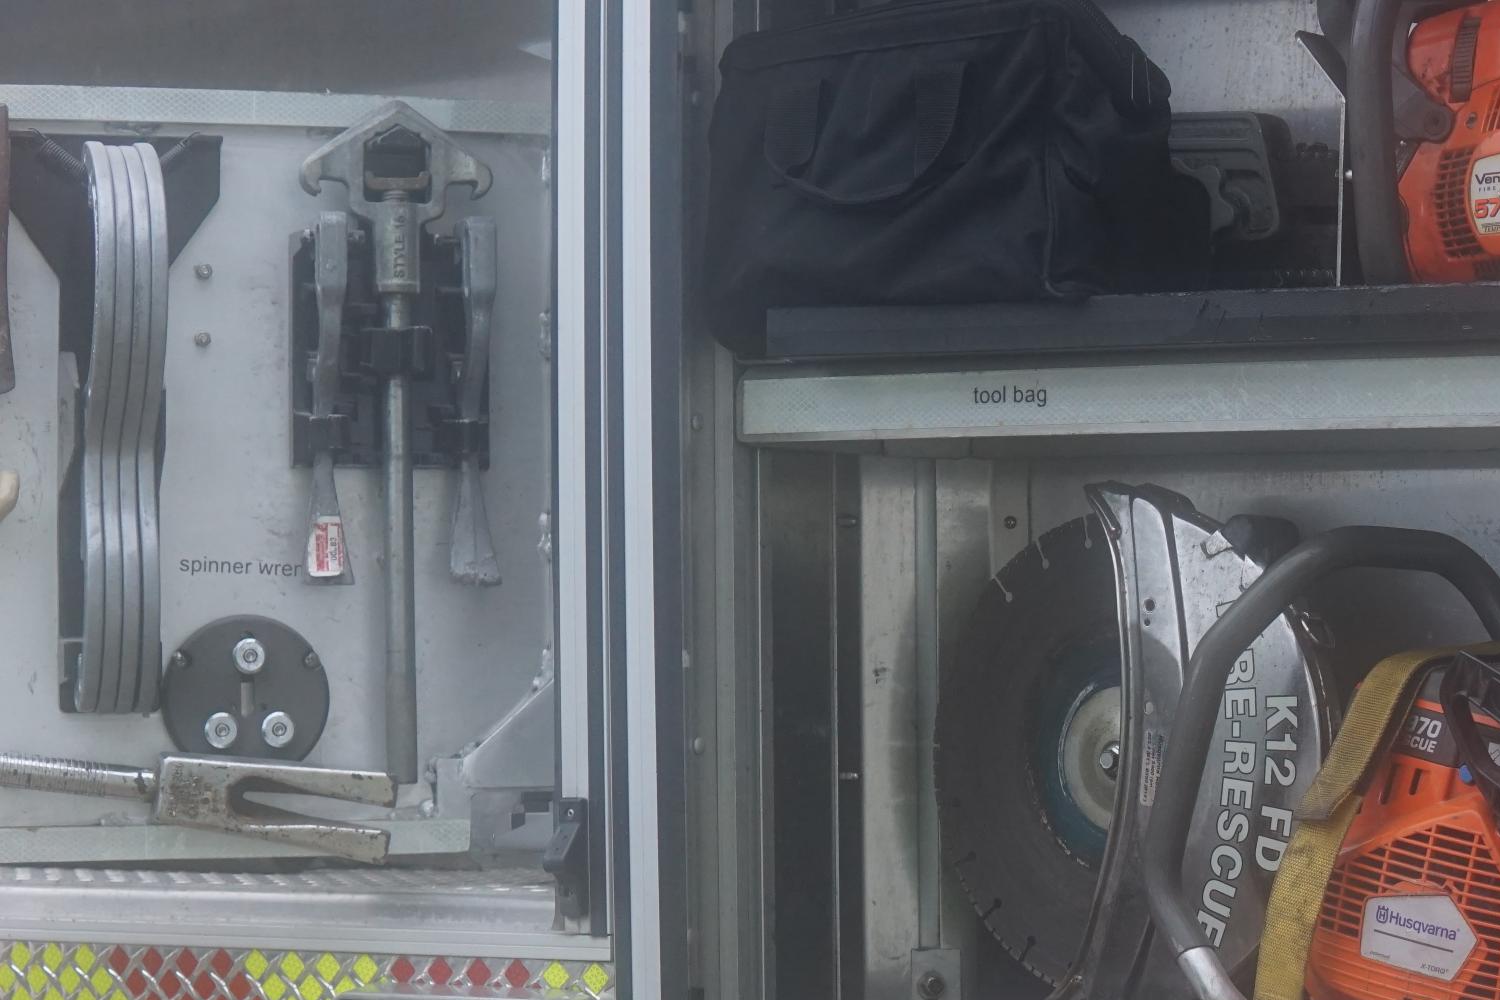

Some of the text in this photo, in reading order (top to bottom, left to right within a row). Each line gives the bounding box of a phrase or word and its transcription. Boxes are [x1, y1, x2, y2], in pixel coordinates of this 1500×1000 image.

[973, 385, 1047, 408] tool bag
[179, 556, 252, 576] spinner
[1264, 695, 1299, 787] K12
[1389, 910, 1457, 941] Husqvarna
